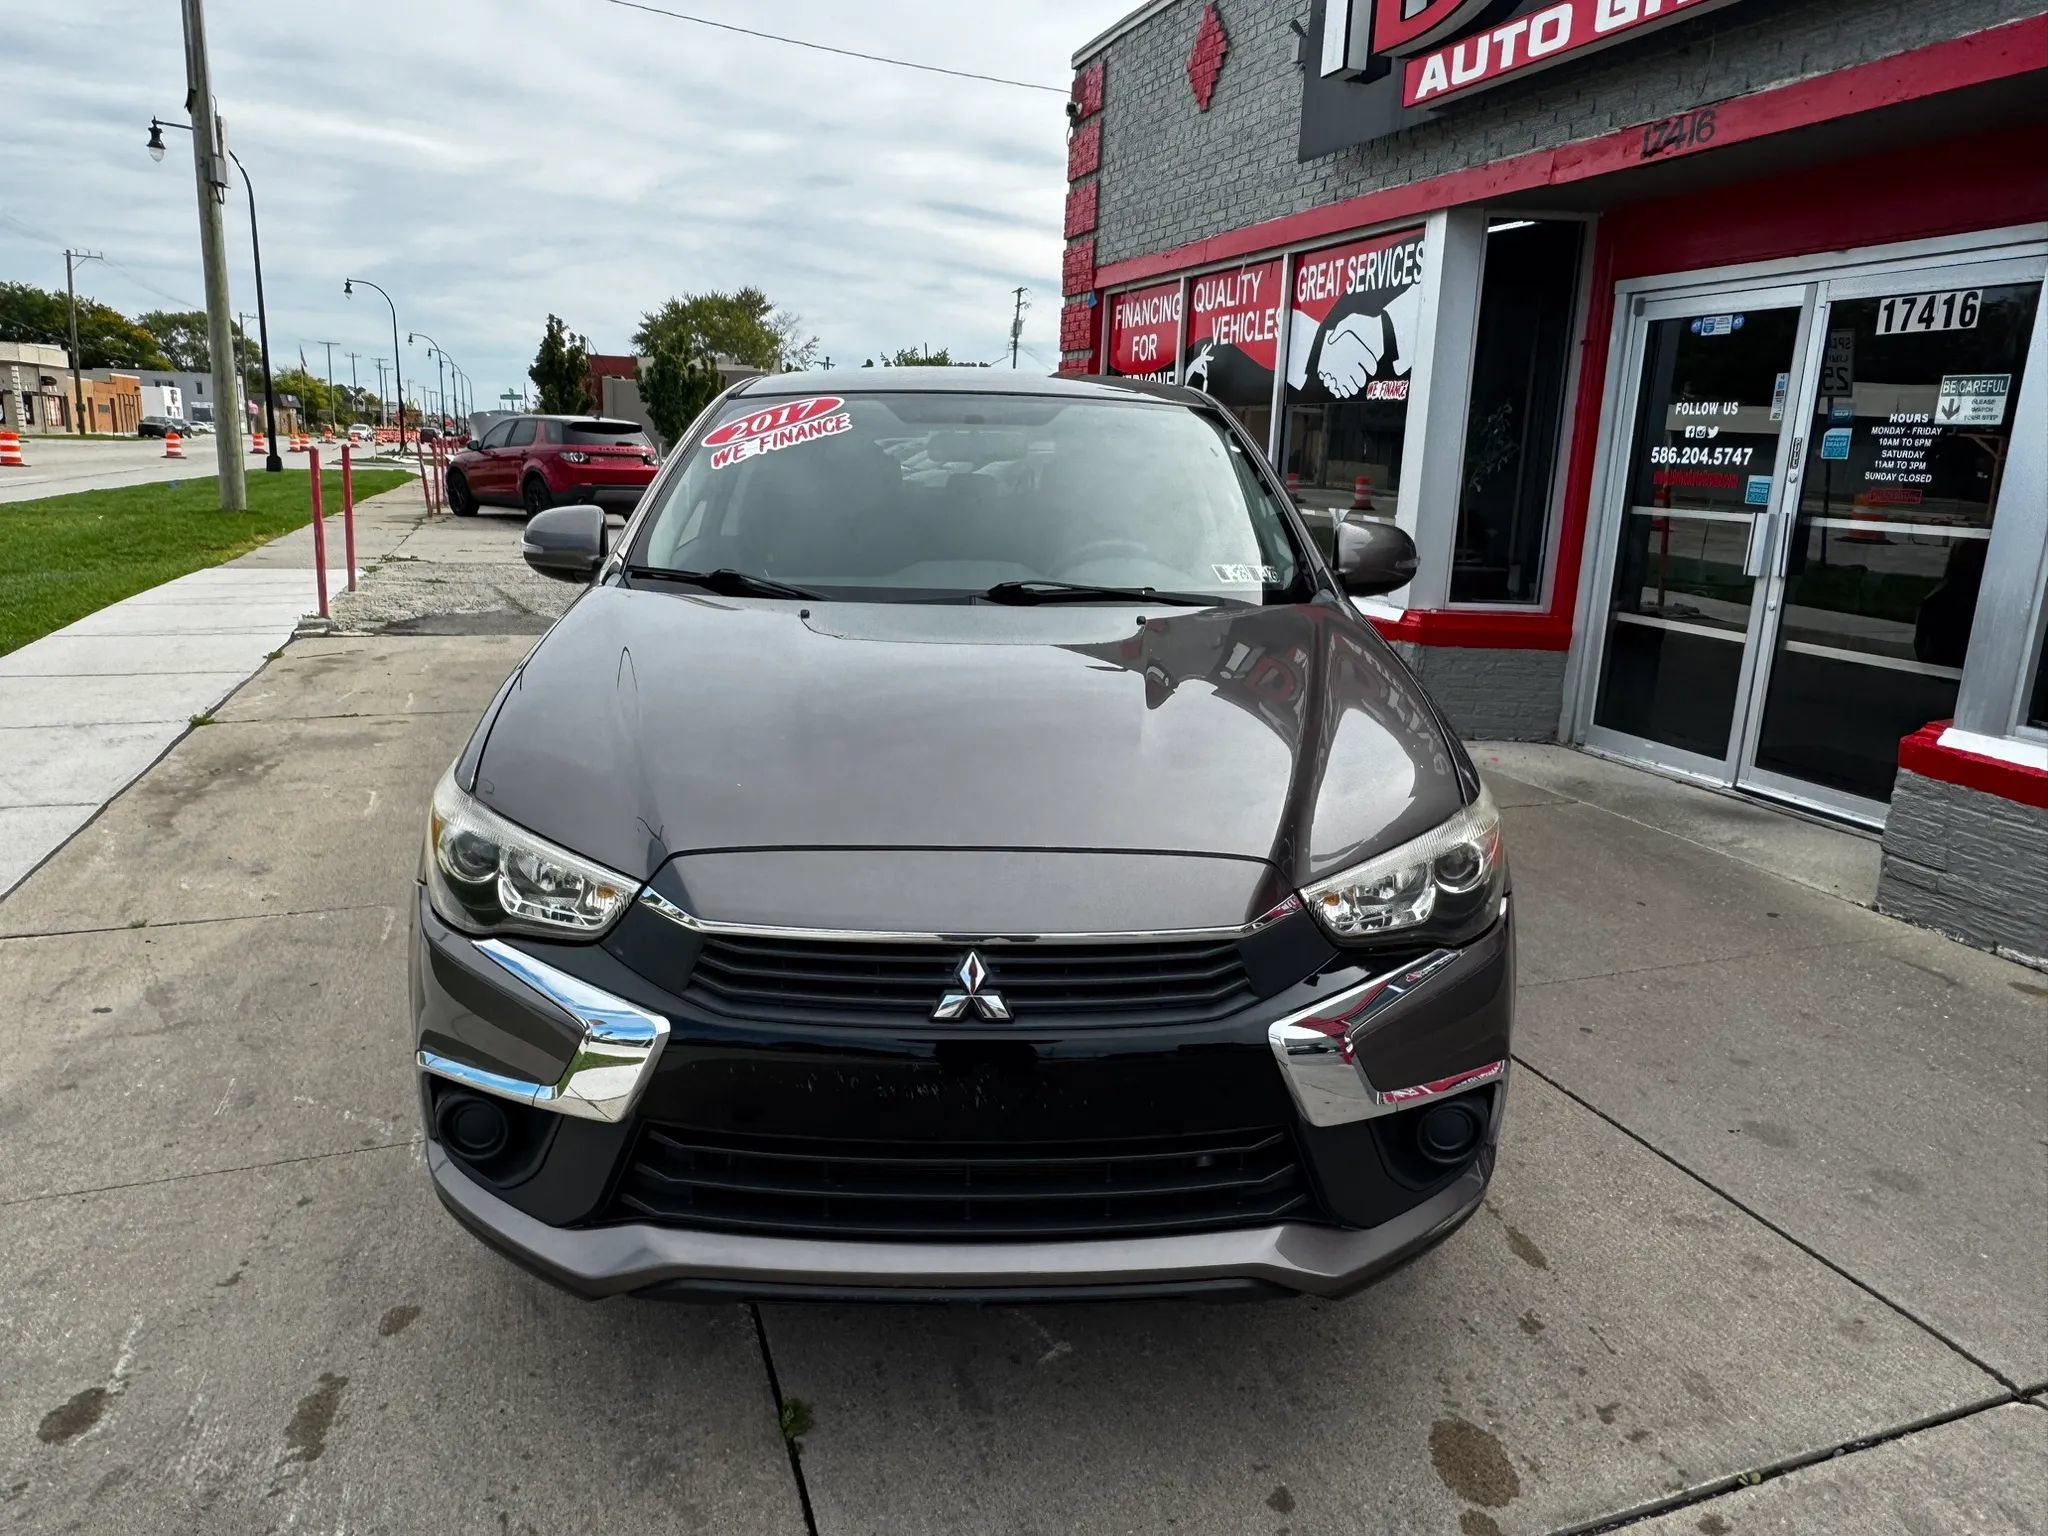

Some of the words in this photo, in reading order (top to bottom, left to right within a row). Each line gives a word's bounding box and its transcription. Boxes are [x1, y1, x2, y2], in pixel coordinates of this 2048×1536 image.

[1415, 3, 1573, 100] AUTO
[1641, 110, 1715, 159] 17416
[1297, 258, 1344, 303] GREAT
[1346, 240, 1425, 295] SERVICES
[1194, 271, 1263, 312] QUALITY
[1115, 292, 1182, 330] FINANCING
[1883, 291, 1978, 333] 17416
[1132, 333, 1157, 362] FOR
[1943, 380, 1957, 393] BE
[1959, 379, 2006, 393] CAREFUL
[1675, 402, 1719, 415] FOLLOW
[1723, 402, 1739, 415] US
[1889, 413, 1929, 423] HOURS
[730, 401, 815, 441] 2017
[1871, 426, 1906, 435] MONDAY
[1912, 426, 1942, 435] FRIDAY
[713, 442, 746, 468] WE
[759, 413, 849, 453] FINANCE
[1879, 438, 1900, 446] 10AM
[1902, 438, 1913, 446] TO
[1914, 438, 1932, 447] 6PM
[1650, 447, 1753, 465] 586.204.5747
[1875, 460, 1895, 468] 11AM
[1897, 460, 1907, 469] TO
[1909, 461, 1926, 470] 3PM
[1881, 449, 1925, 458] SATURDAY
[1865, 471, 1897, 480] SUNDAY
[1898, 473, 1932, 483] CLOSED
